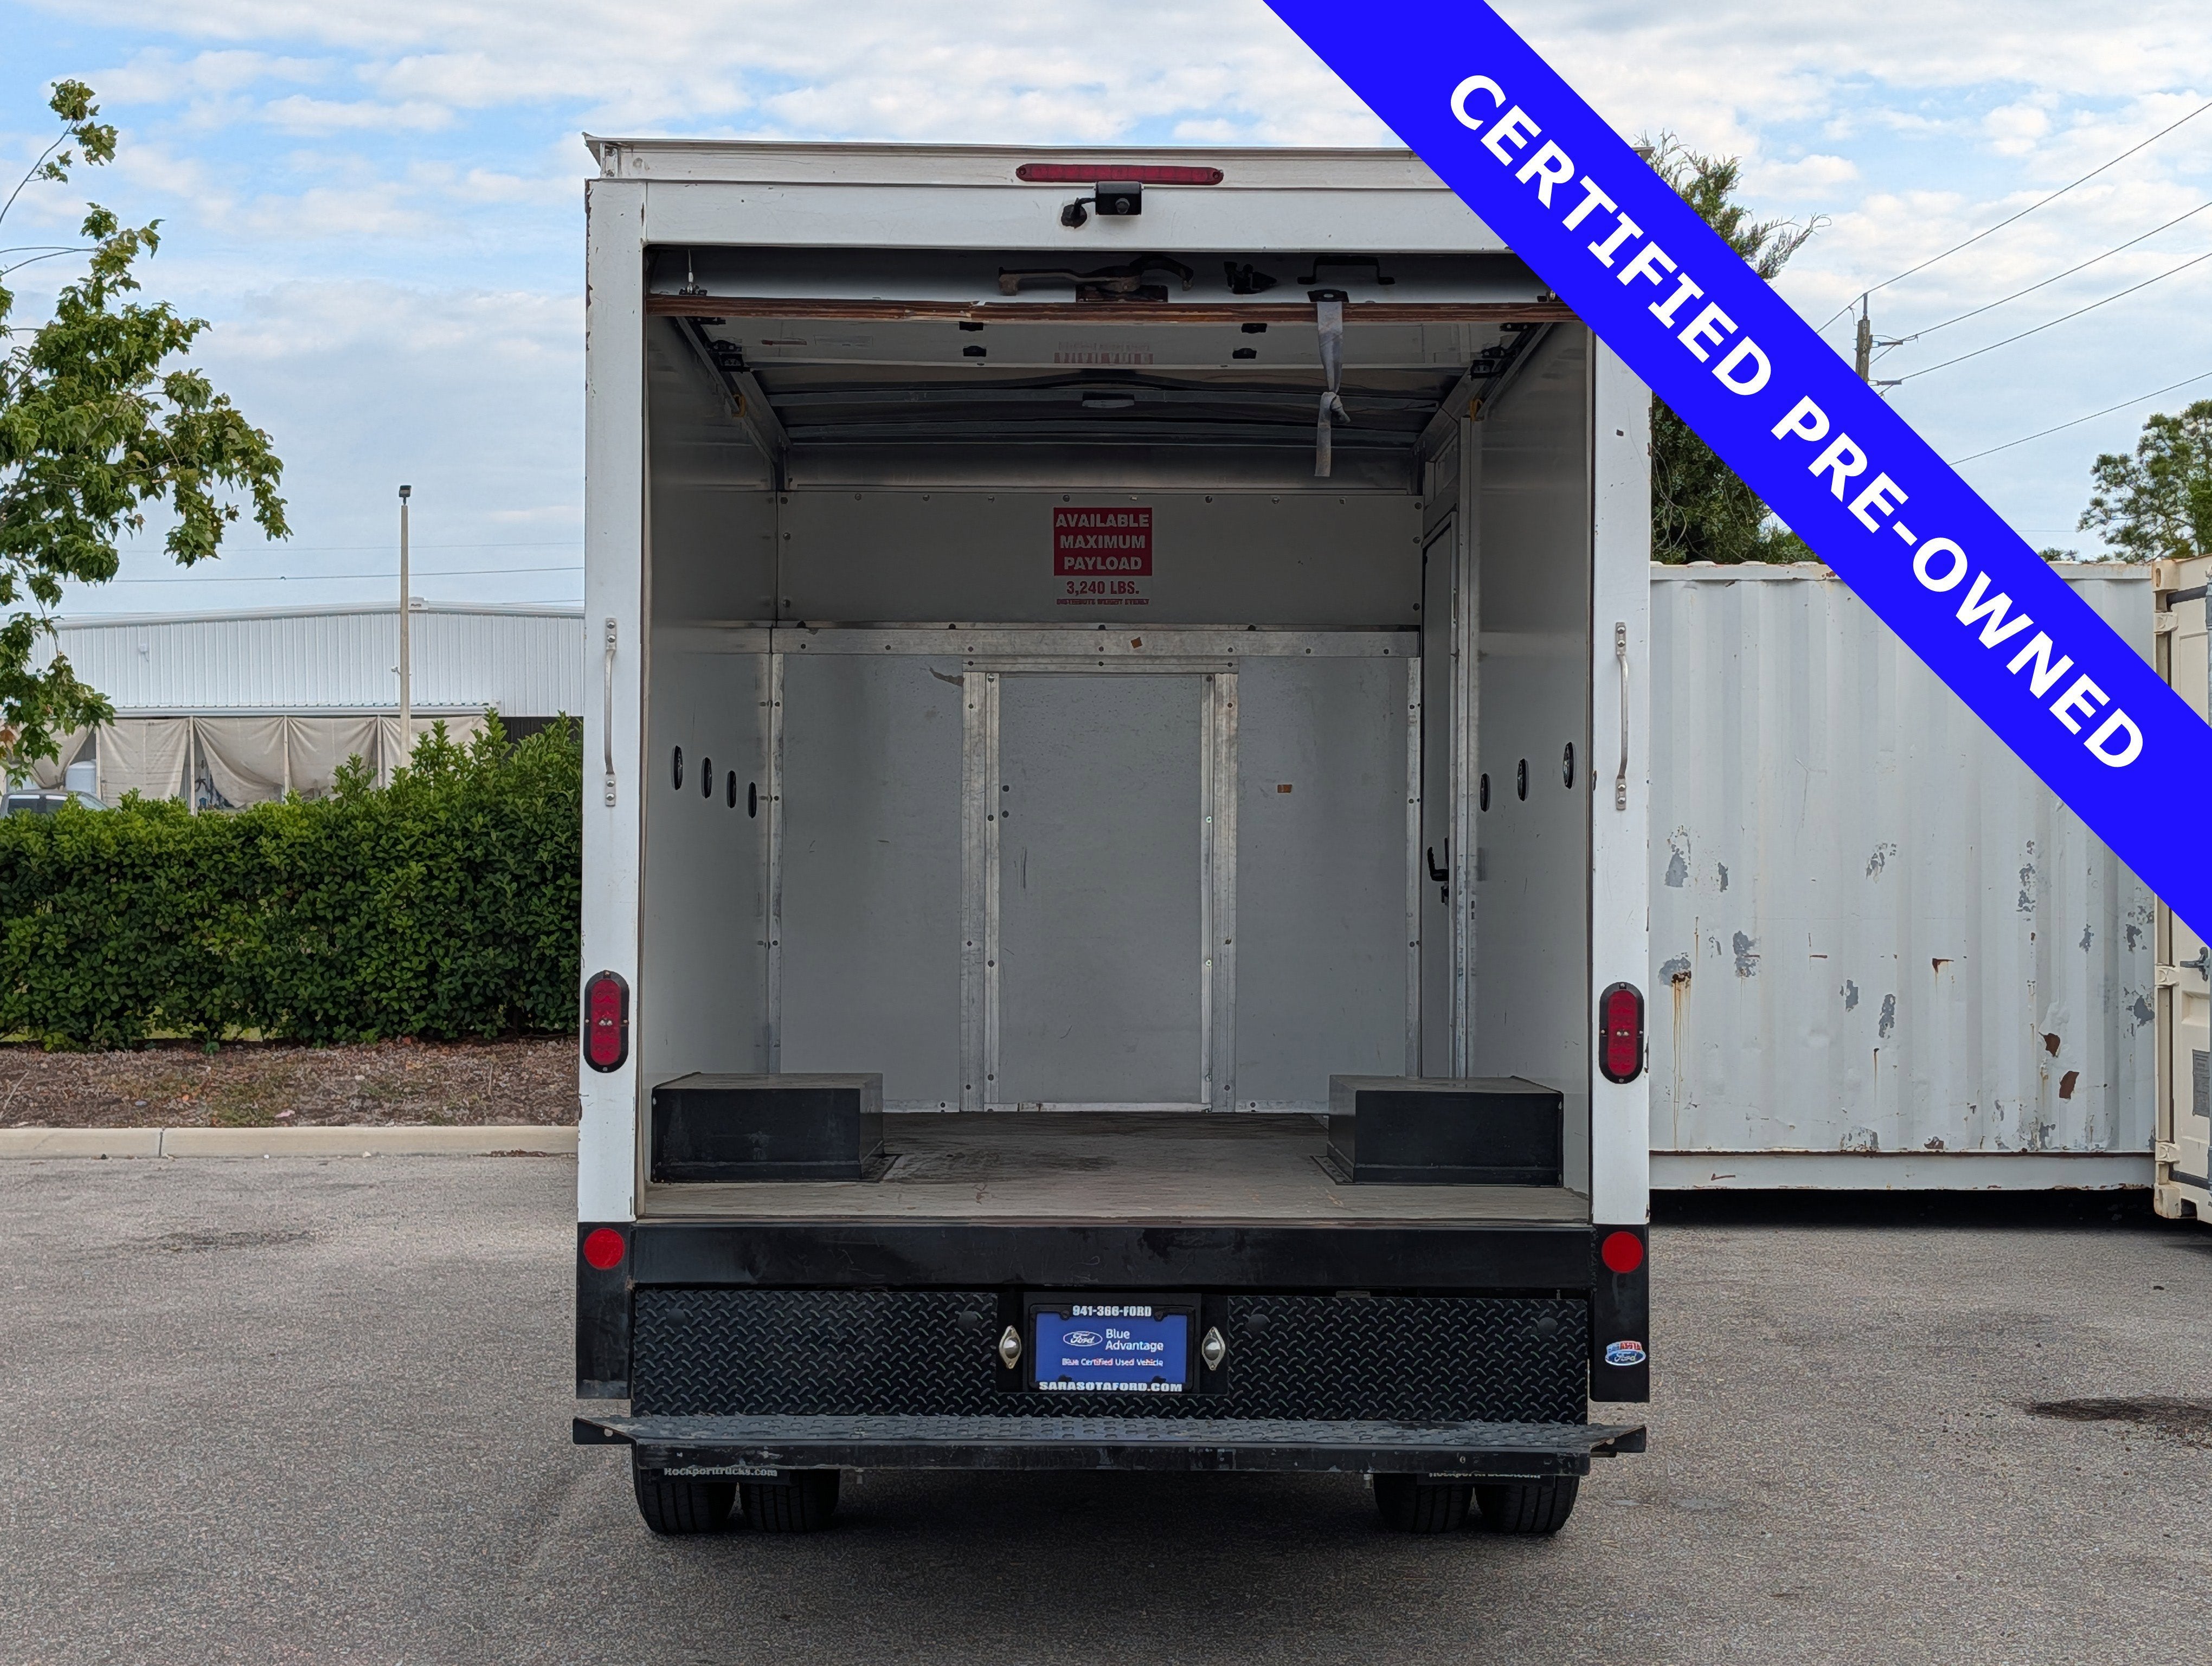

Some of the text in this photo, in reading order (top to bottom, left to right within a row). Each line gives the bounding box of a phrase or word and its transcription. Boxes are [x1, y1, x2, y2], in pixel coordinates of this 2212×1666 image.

[1056, 514, 1149, 527] AVAILABLE
[1060, 535, 1145, 548] MAXIMUM
[1064, 556, 1142, 570] PAYLOAD
[1066, 581, 1139, 595] 3,240 LBS.
[1072, 1305, 1152, 1317] 941-366-FORD
[1105, 1329, 1130, 1339] Blue
[1105, 1340, 1163, 1353] Advantage
[1115, 1358, 1135, 1366] Used
[1136, 1359, 1163, 1367] Vehicle
[1039, 1381, 1182, 1392] SARASOTAFORD.COM
